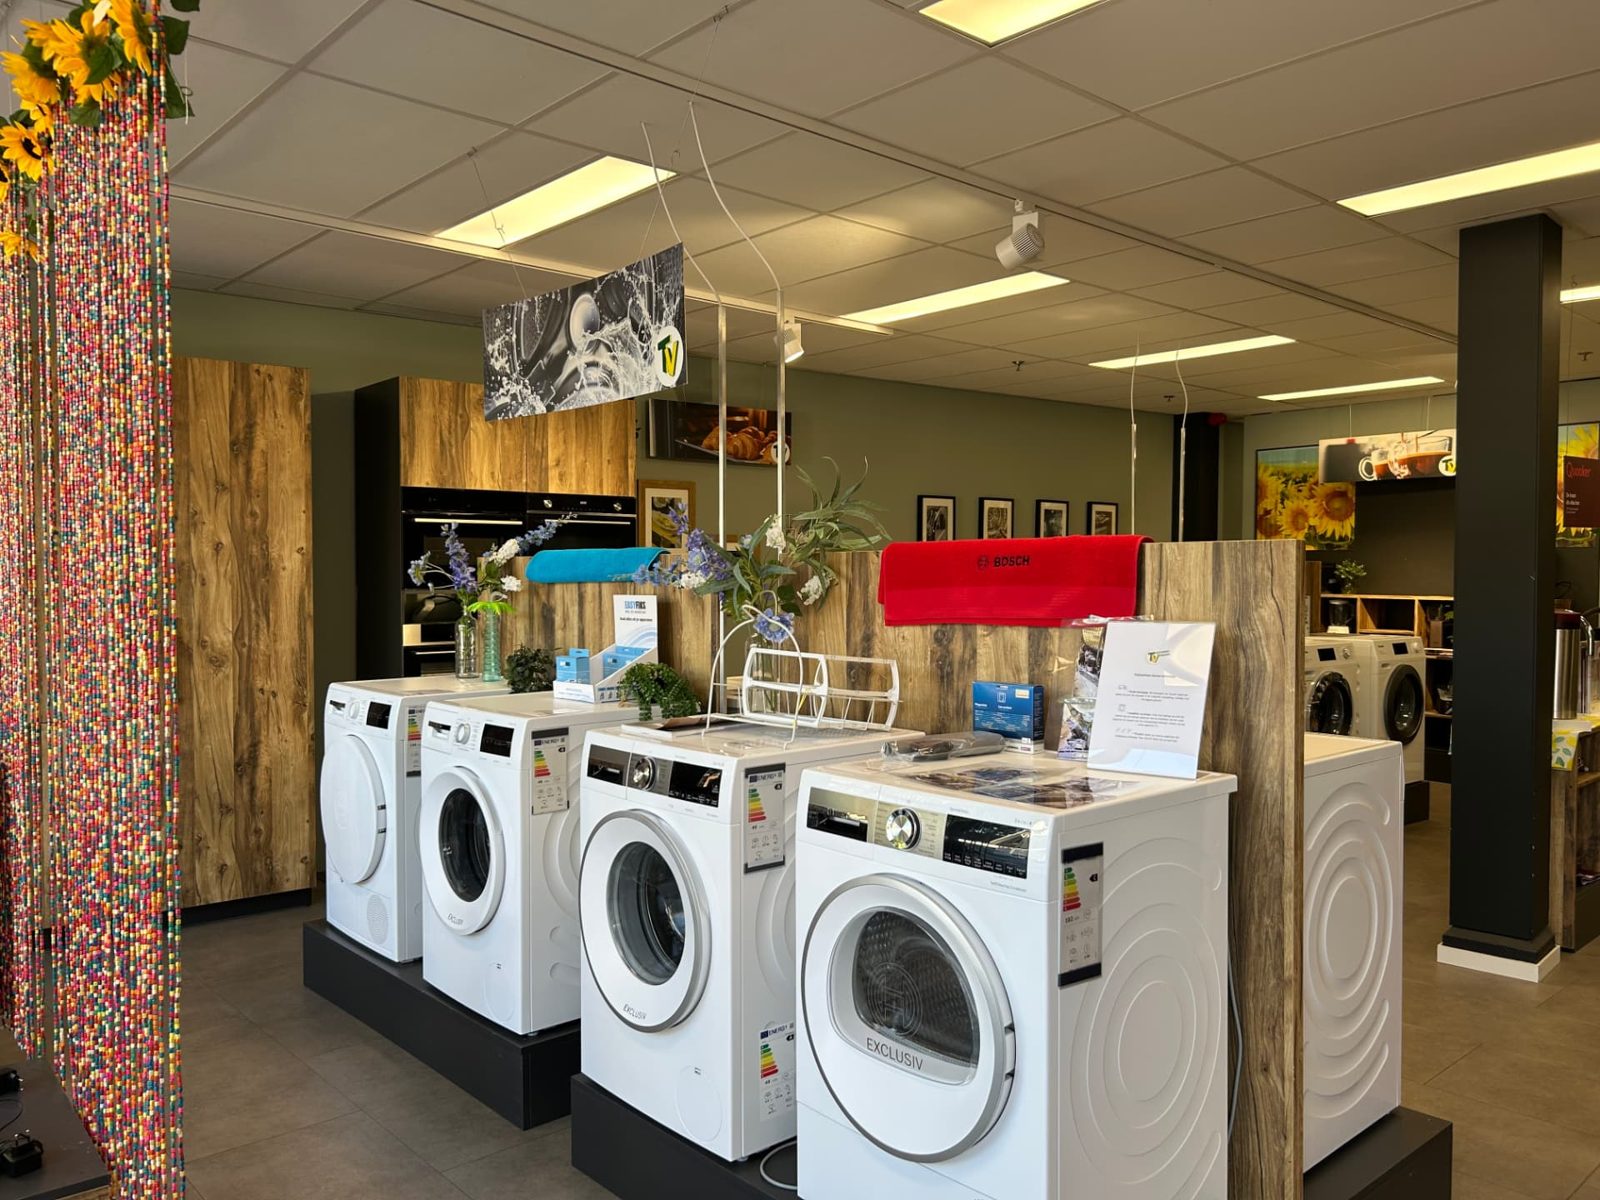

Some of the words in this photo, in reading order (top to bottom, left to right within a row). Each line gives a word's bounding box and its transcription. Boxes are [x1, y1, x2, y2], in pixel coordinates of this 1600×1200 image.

[657, 335, 679, 377] TV
[993, 555, 1030, 568] BOSCH
[866, 1037, 924, 1071] EXCLUSIV
